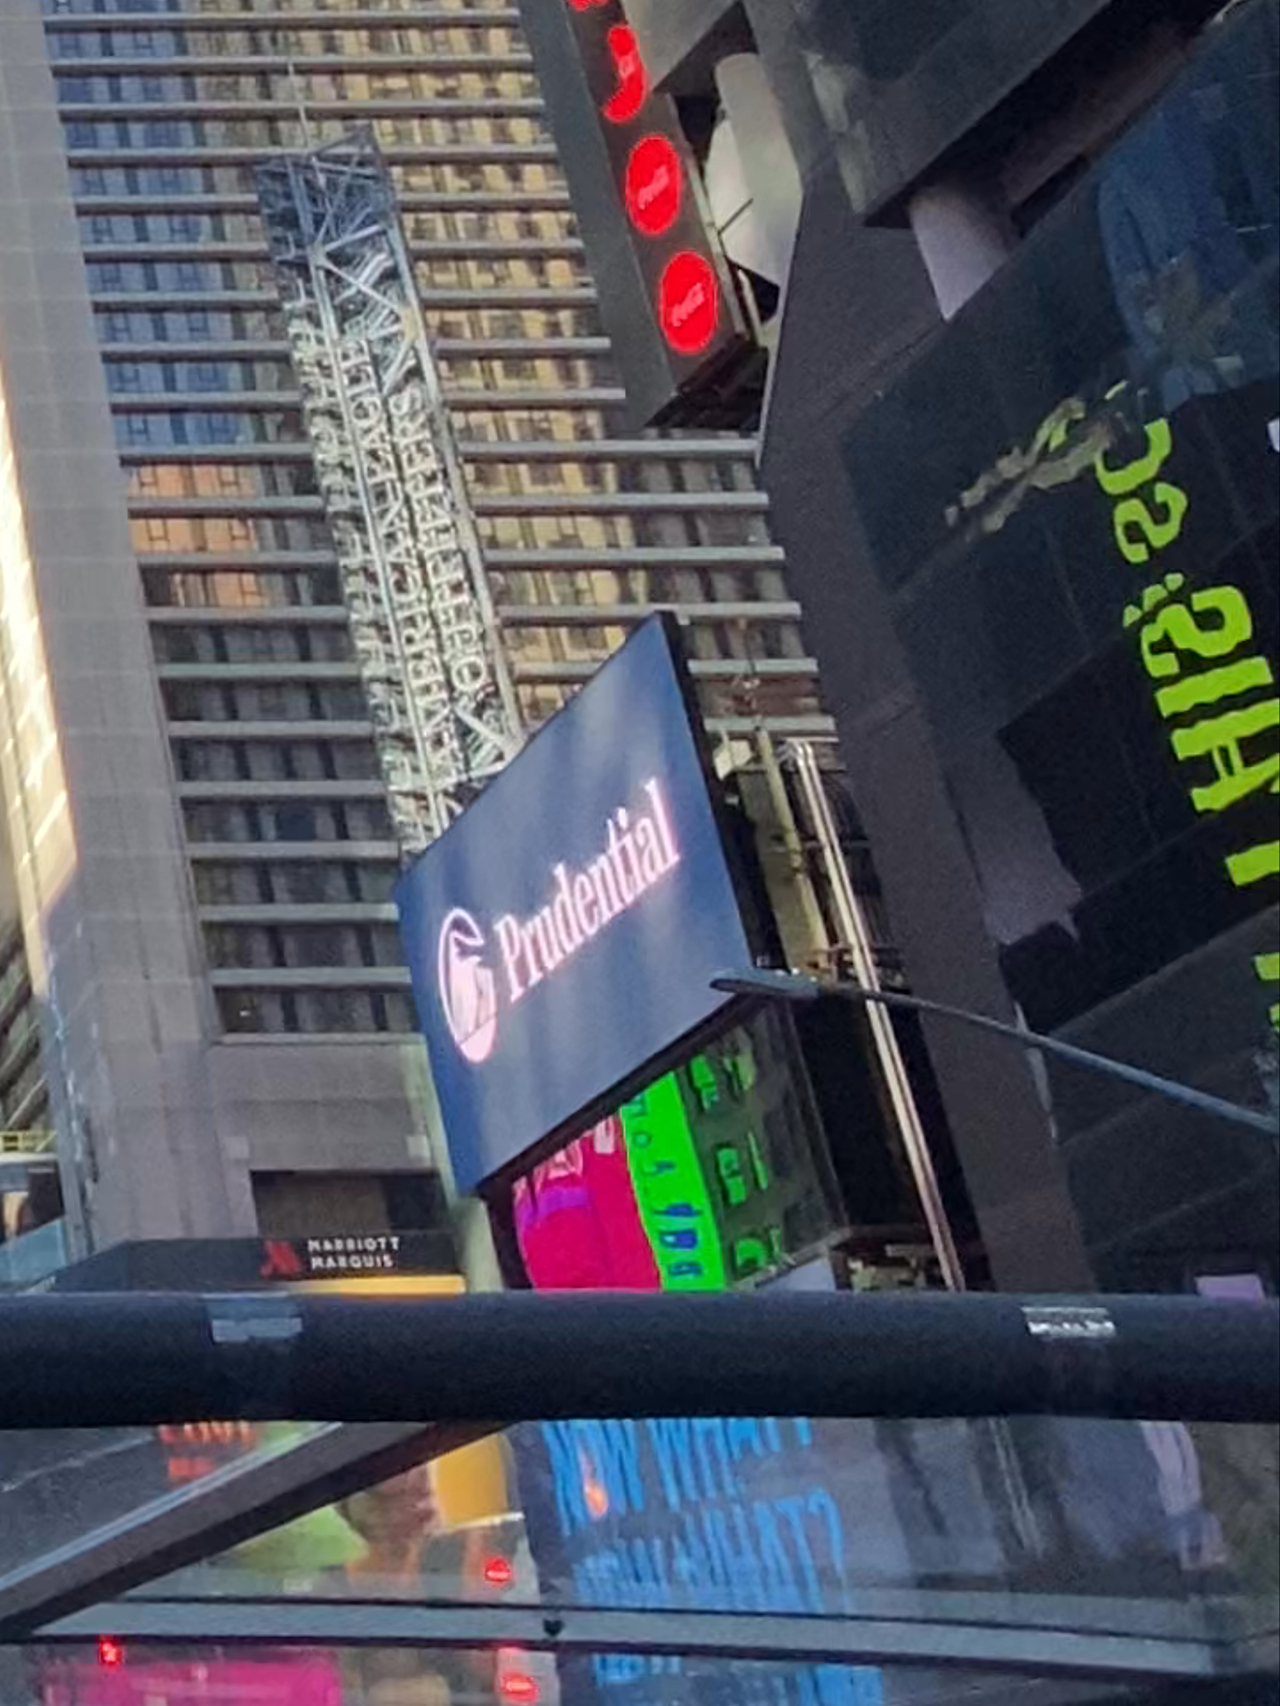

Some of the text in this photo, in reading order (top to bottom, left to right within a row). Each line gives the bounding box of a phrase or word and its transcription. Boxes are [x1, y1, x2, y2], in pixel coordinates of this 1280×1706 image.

[492, 775, 680, 1003] Prudential
[307, 1236, 400, 1252] MARRIOTT
[310, 1254, 394, 1270] MARQUIS
